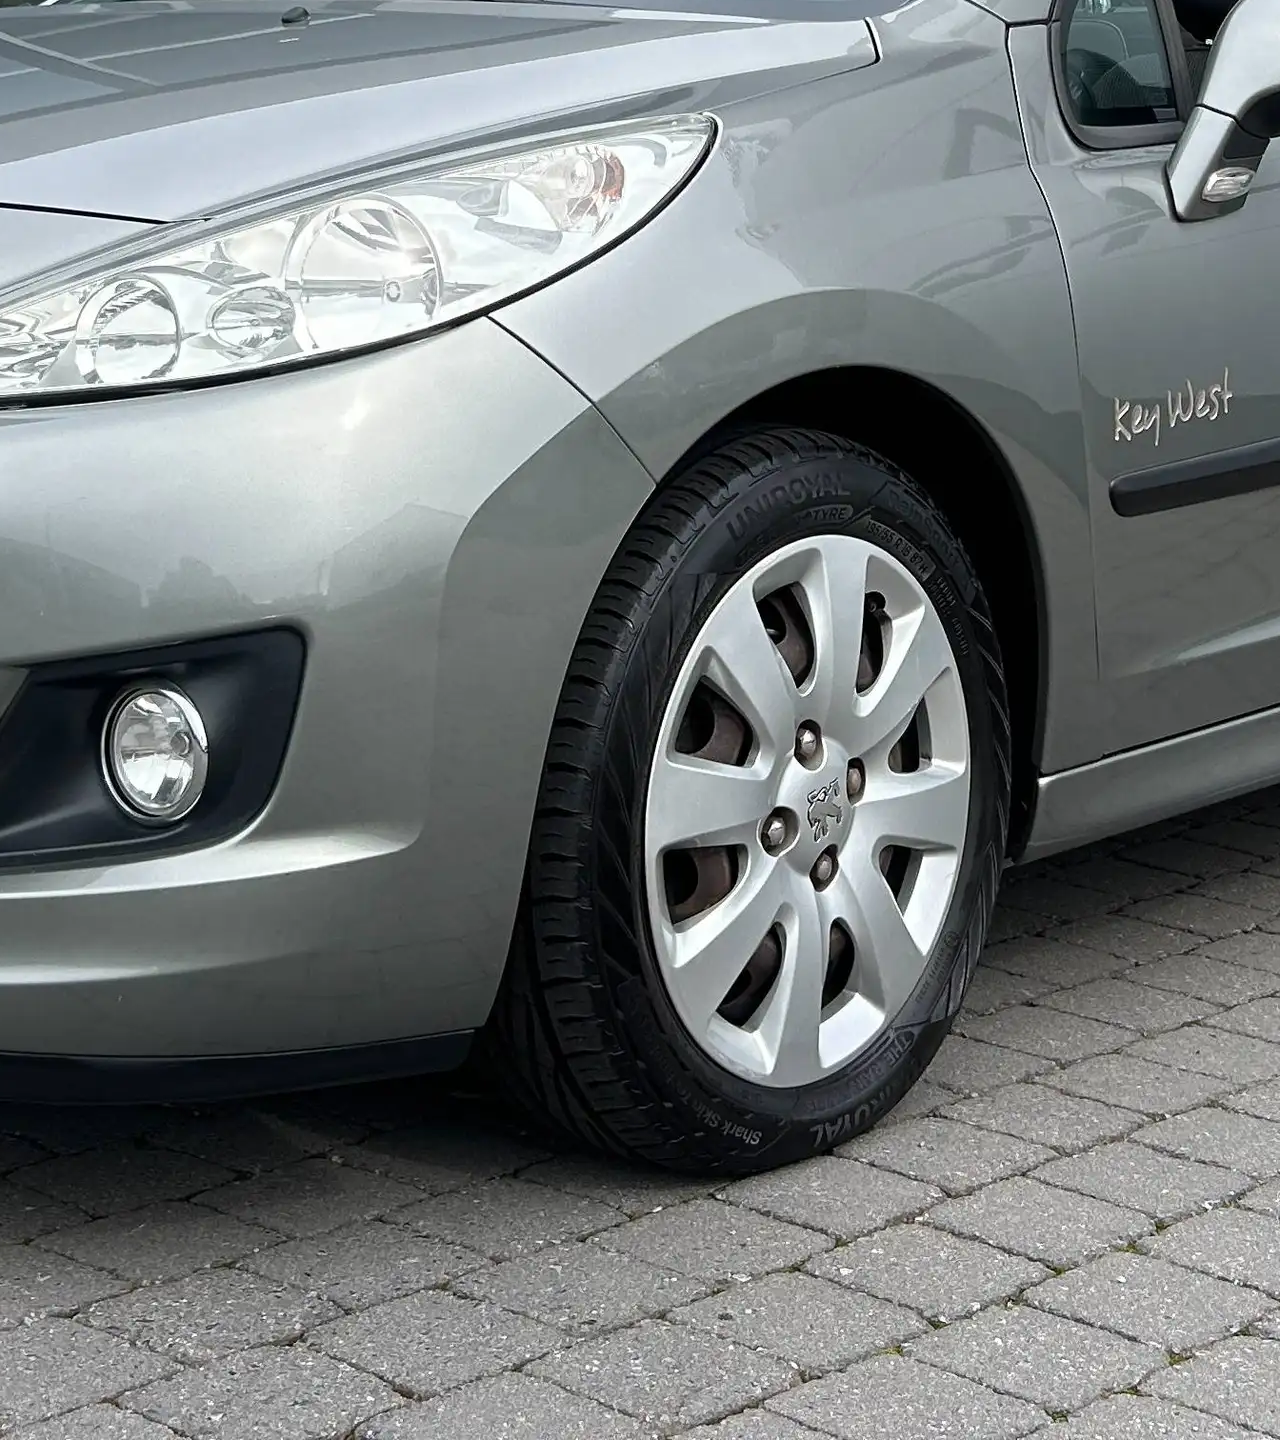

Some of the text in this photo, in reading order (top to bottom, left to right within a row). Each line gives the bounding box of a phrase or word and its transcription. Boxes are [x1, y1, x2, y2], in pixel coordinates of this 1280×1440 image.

[1113, 366, 1233, 447] Key West
[721, 1117, 763, 1145] Shark
